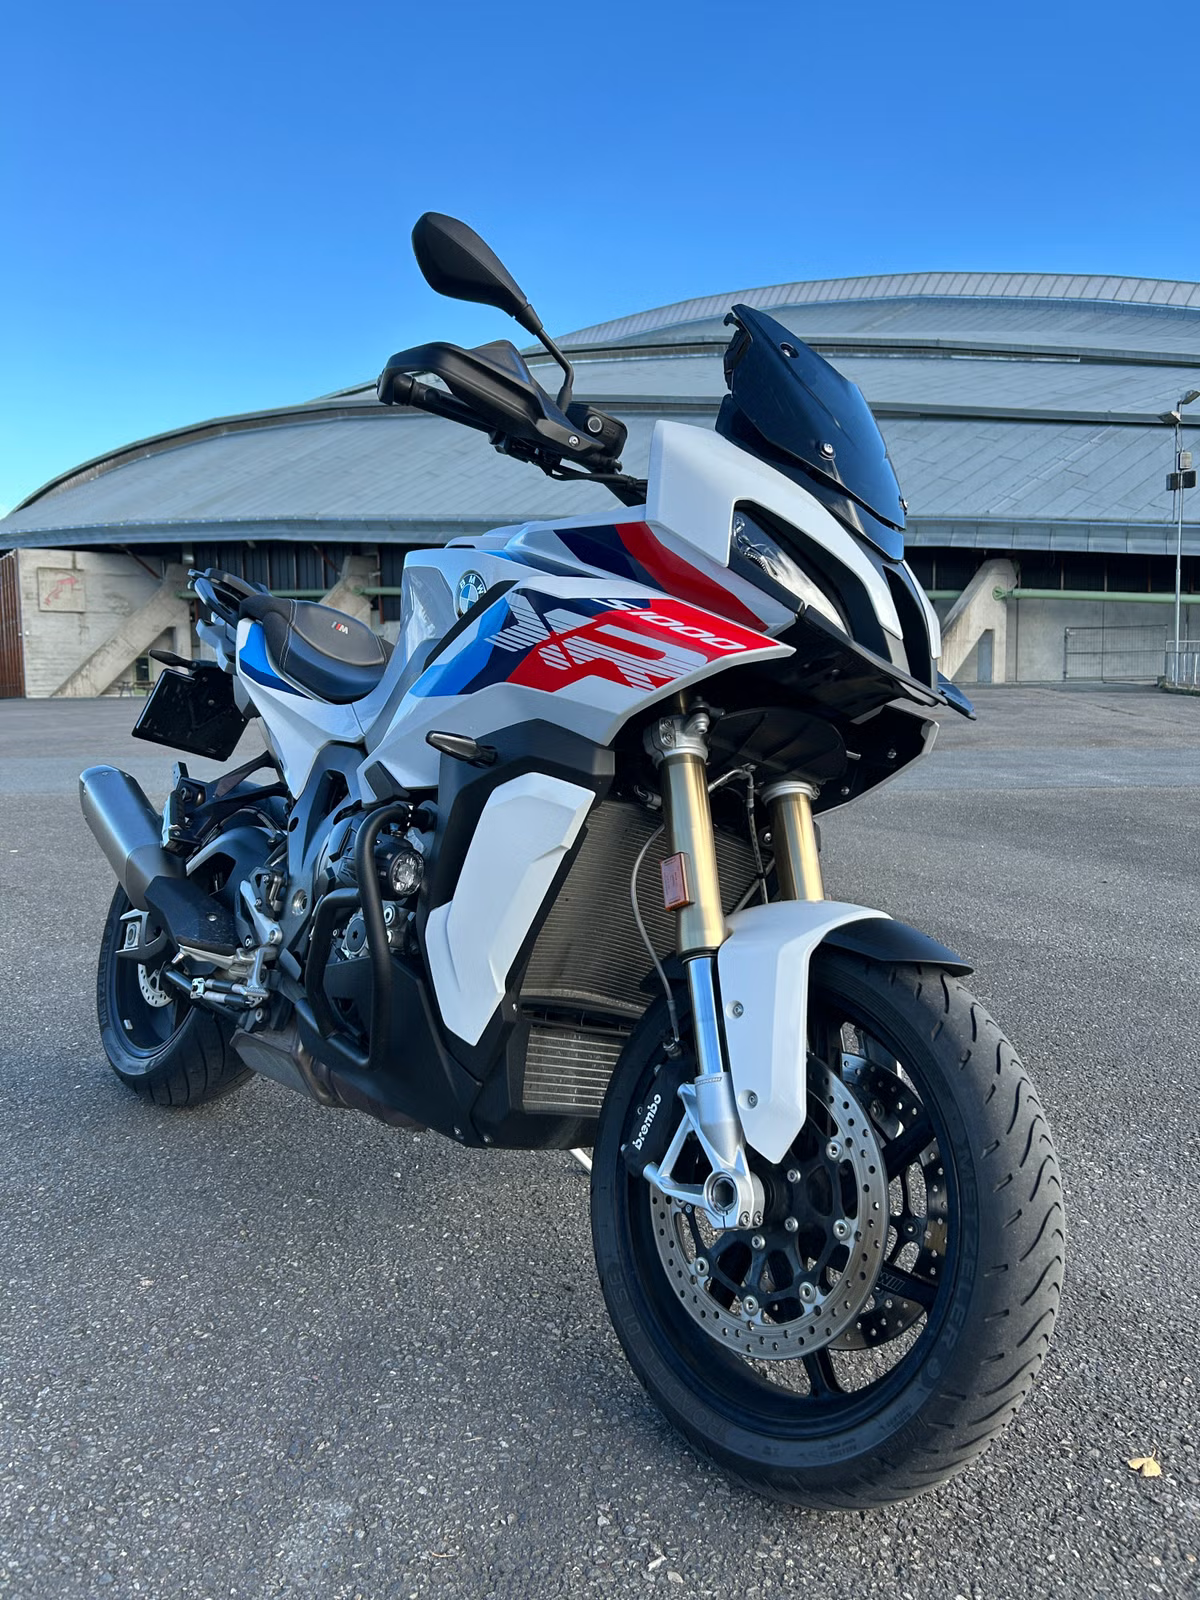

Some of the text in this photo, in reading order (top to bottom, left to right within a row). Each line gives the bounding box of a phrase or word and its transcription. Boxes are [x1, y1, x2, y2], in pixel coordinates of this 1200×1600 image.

[459, 574, 484, 595] BMW
[97, 941, 110, 1025] METZELER
[632, 1093, 661, 1151] brembo
[940, 1146, 977, 1350] METZELER
[621, 1313, 641, 1337] 01
[639, 1346, 726, 1441] ROADTEC
